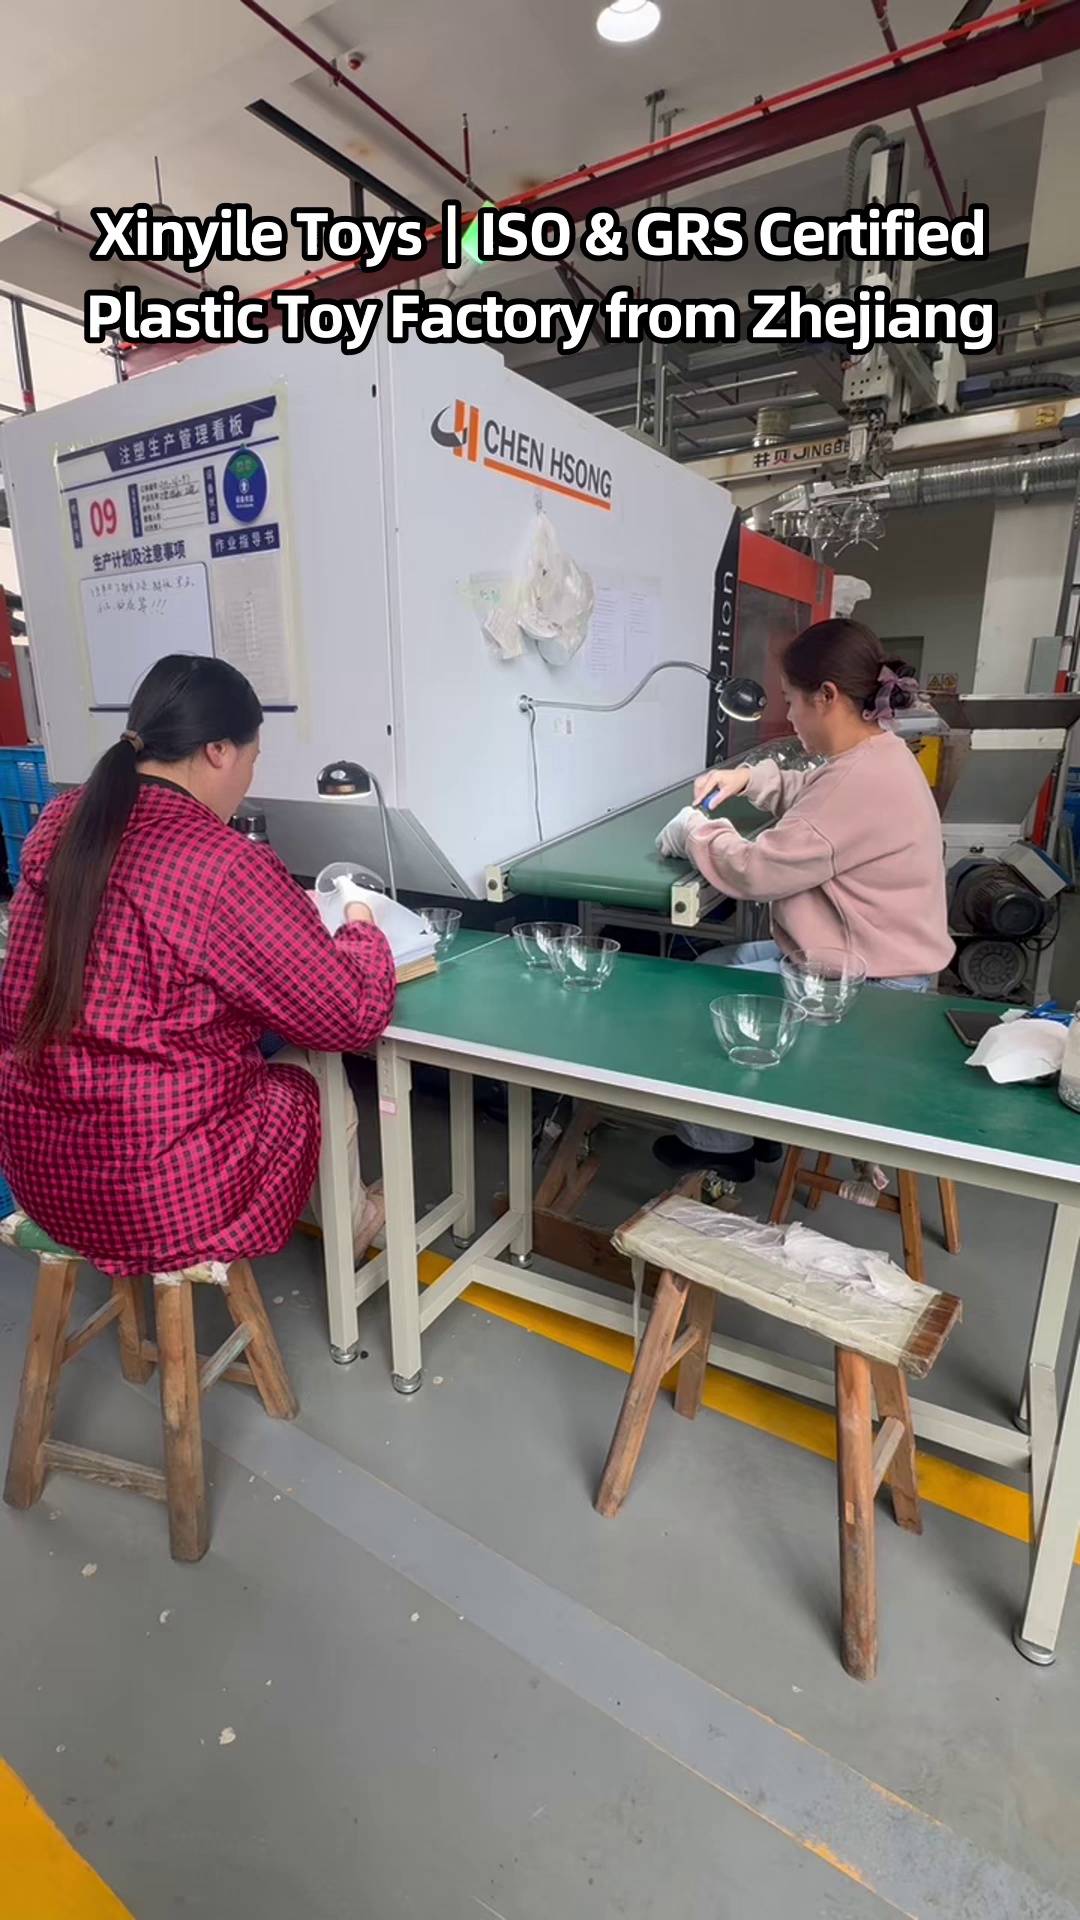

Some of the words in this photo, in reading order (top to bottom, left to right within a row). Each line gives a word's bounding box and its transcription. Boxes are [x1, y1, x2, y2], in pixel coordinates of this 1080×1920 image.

[119, 413, 244, 466] 注塑生产管理看板
[483, 419, 544, 472] CHEN
[550, 447, 612, 499] HSONG
[89, 497, 118, 538] 09
[92, 540, 187, 572] 生产计划及注意事项
[215, 529, 275, 553] 作业指导书
